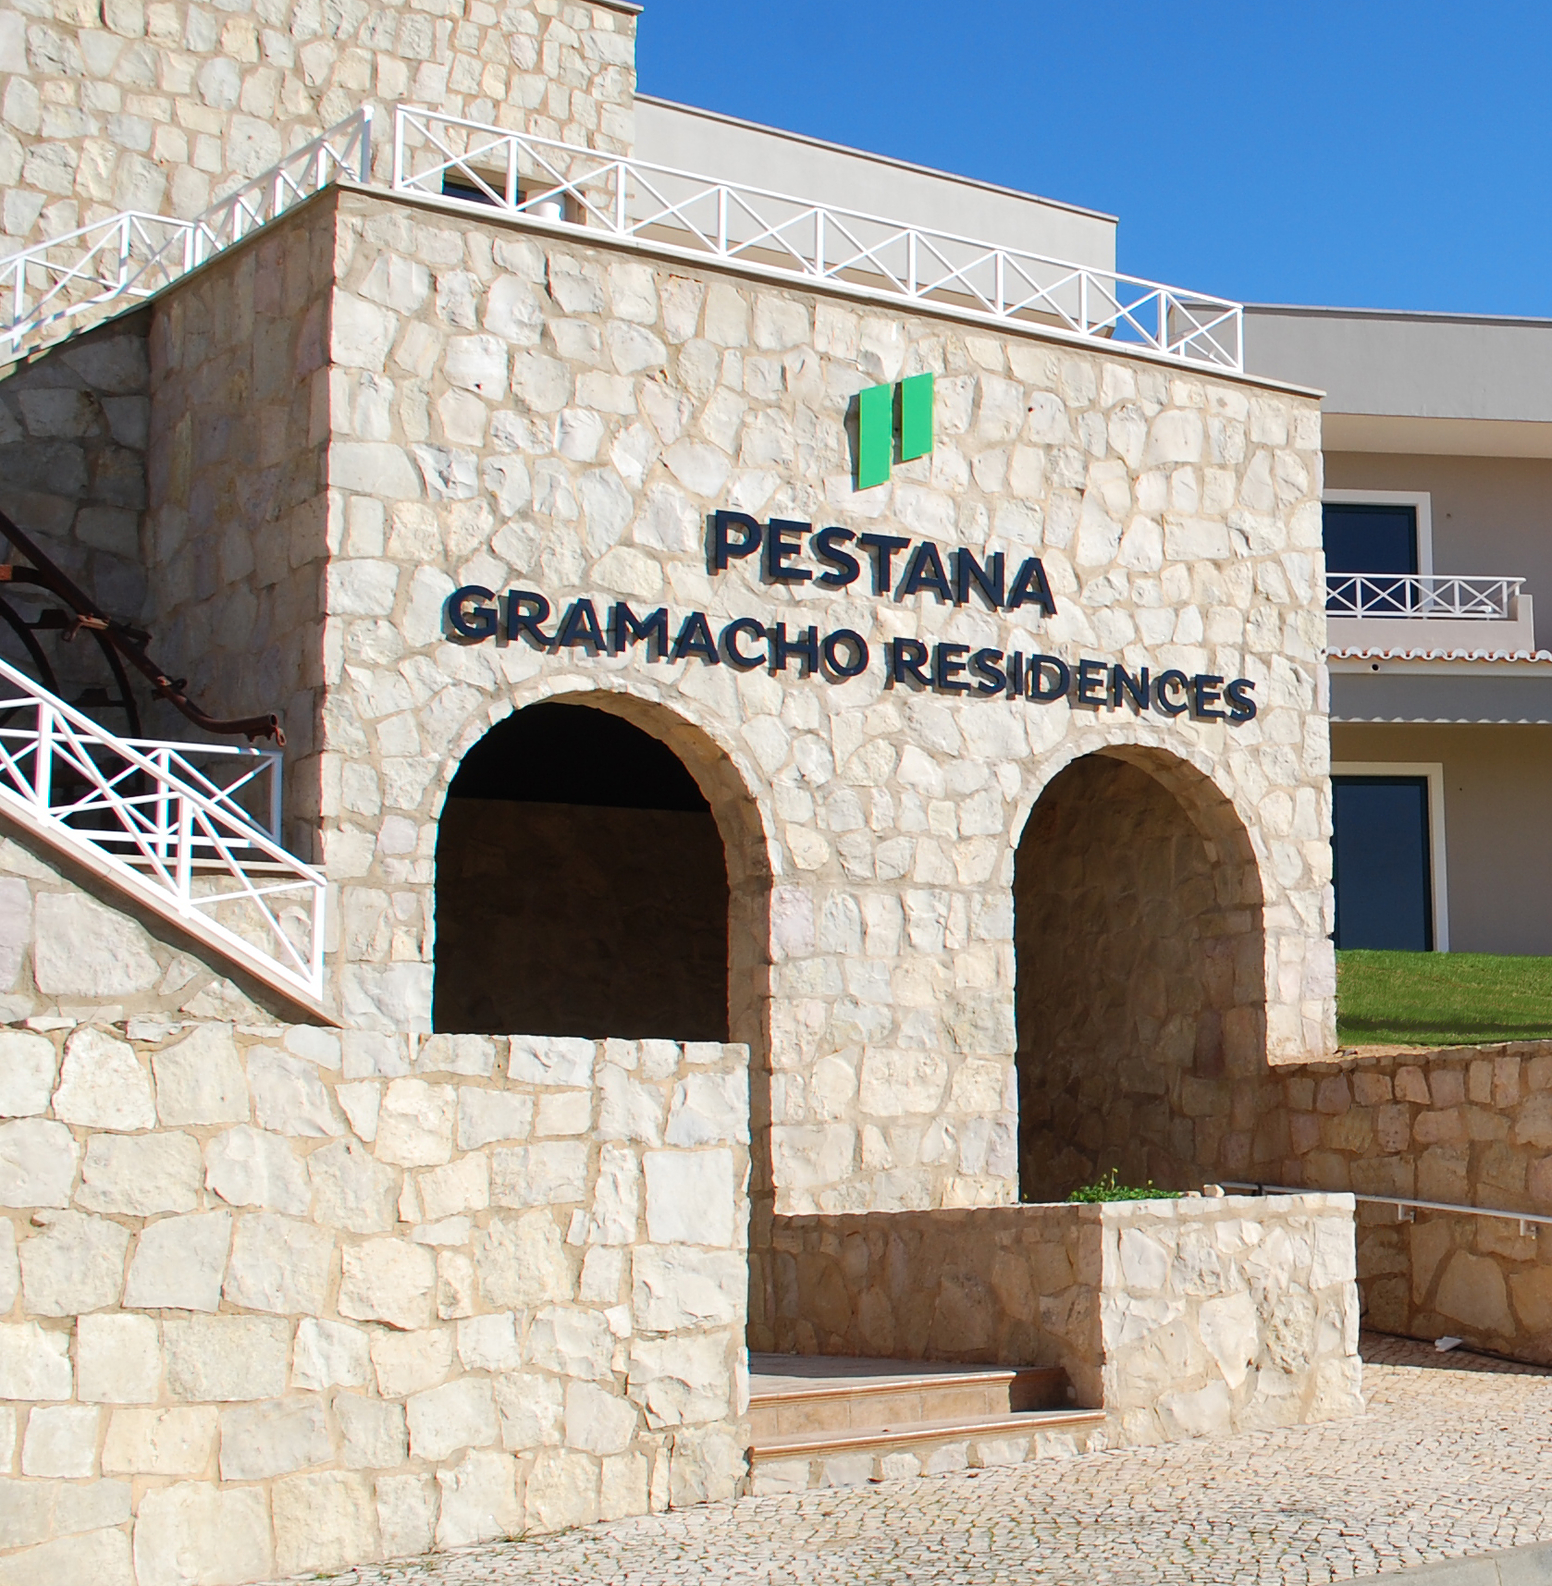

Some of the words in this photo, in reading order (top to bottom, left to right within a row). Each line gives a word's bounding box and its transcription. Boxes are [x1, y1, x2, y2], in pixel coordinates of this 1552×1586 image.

[715, 509, 1058, 615] PESTANA
[448, 584, 870, 677] GRAMACHO
[893, 636, 1258, 722] RESIDENCES
